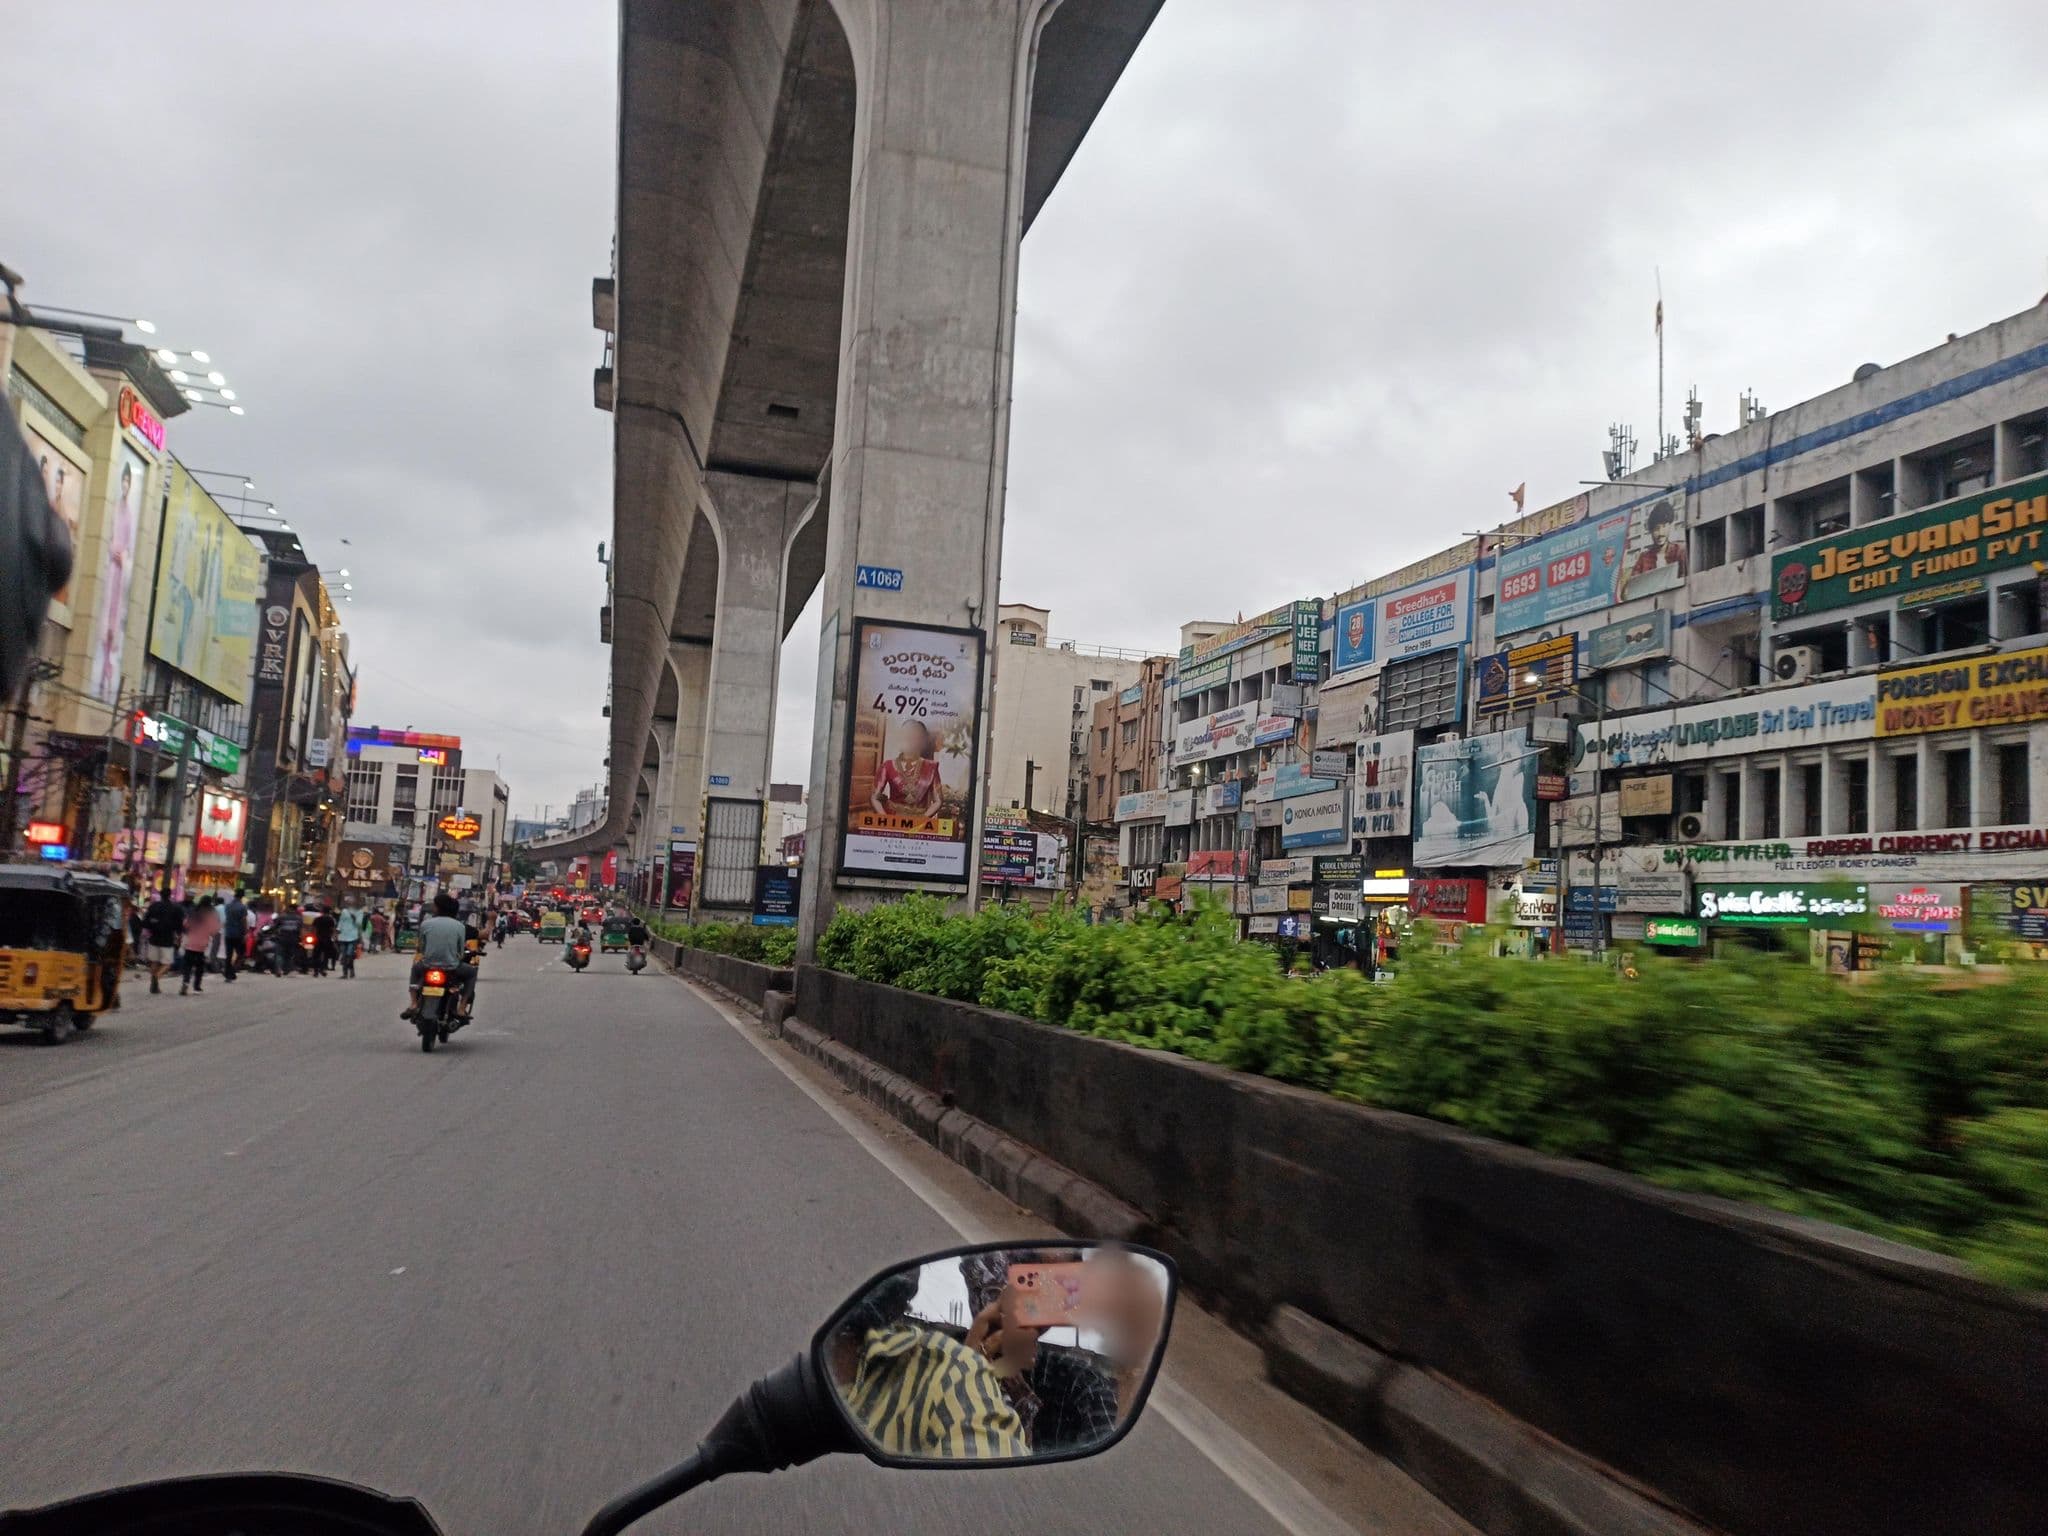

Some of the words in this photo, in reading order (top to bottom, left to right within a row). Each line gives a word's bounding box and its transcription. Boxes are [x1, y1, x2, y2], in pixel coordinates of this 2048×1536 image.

[1551, 556, 1586, 583] 1849
[1849, 565, 1902, 593] CHIT
[1911, 549, 1978, 578] FUND
[1987, 530, 2043, 559] PVT
[1503, 573, 1537, 598] 5693
[1298, 602, 1319, 611] SPARK
[1395, 591, 1447, 615] Sreedhar's
[1298, 613, 1319, 625] IIT
[1351, 617, 1361, 630] 28
[1402, 613, 1435, 627] COLLEGE
[1437, 604, 1452, 617] FOR
[1298, 627, 1318, 638] JEE
[1299, 640, 1316, 652] NEET
[1878, 667, 1970, 703] FOREIGN
[1978, 655, 2048, 689] EXCH
[1761, 709, 1784, 734] Sri
[1788, 705, 1815, 730] Sai
[1819, 695, 1876, 725] Travel
[1884, 702, 1963, 731] MONEY
[864, 816, 934, 830] BHIMA
[1807, 840, 1873, 857] FOREIGN
[1879, 833, 1972, 855] CURRENCY
[337, 867, 386, 881] VRK
[1775, 862, 1794, 871] FULL
[1796, 860, 1836, 870] FLEDGED
[1837, 858, 1869, 868] MONEY
[1871, 857, 1918, 868] CHANGER
[1130, 868, 1155, 887] NEXT
